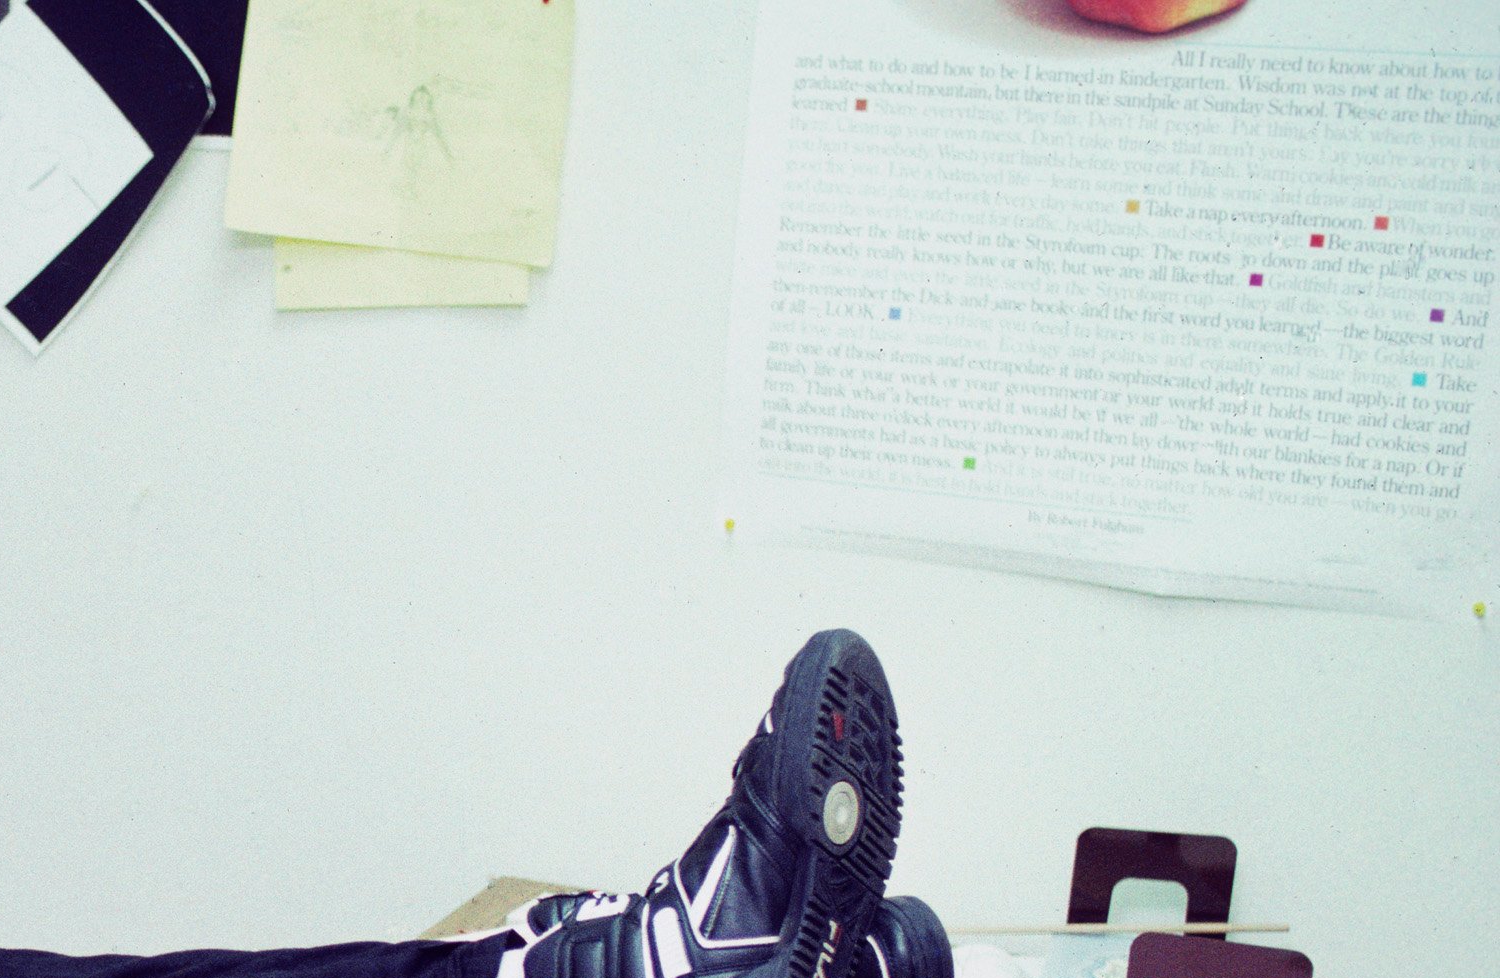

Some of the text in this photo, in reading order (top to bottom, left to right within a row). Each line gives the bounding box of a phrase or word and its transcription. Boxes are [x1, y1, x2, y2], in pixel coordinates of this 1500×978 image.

[794, 53, 825, 69] and
[826, 54, 865, 71] what
[866, 57, 885, 72] to
[886, 57, 909, 74] do
[909, 59, 941, 75] and
[941, 60, 975, 77] how
[977, 63, 997, 78] to
[998, 63, 1019, 80] be
[1023, 64, 1032, 80] I
[1034, 65, 1096, 84] learned
[1097, 69, 1115, 85] in
[1118, 69, 1232, 93] kindergarten.
[1237, 76, 1308, 96] Wisdom
[1312, 84, 1347, 98] was
[1349, 85, 1379, 100] not
[1382, 86, 1401, 101] at
[1404, 86, 1434, 103] the
[1438, 89, 1469, 109] top
[1174, 49, 1493, 82] All I really need to know about how to
[792, 74, 915, 95] graduate-school
[993, 84, 1021, 101] but
[1022, 86, 1061, 103] there
[1065, 88, 1083, 105] in
[1083, 89, 1110, 106] the
[1113, 92, 1177, 113] sandpile
[1182, 97, 1200, 112] at
[1202, 96, 1262, 119] Sunday
[1266, 99, 1331, 119] School.
[1389, 111, 1419, 124] are
[1422, 109, 1452, 126] the
[1144, 199, 1370, 231] Take a nap every afternoon.
[994, 231, 1021, 248] the
[1024, 232, 1108, 254] Styrofoam
[1152, 242, 1184, 260] The
[1187, 248, 1232, 264] roots
[1260, 250, 1308, 270] down
[1310, 255, 1344, 272] and
[1346, 257, 1375, 275] the
[1425, 266, 1468, 284] goes
[1470, 270, 1491, 288] up
[999, 255, 1017, 268] or
[1022, 254, 1057, 275] why,
[1060, 256, 1088, 274] but
[1091, 262, 1116, 276] we
[1118, 264, 1145, 278] are
[1148, 263, 1169, 280] all
[1170, 264, 1200, 283] like
[1201, 267, 1241, 286] that.
[1326, 233, 1352, 251] Be
[1356, 240, 1402, 255] aware
[1427, 243, 1495, 262] wonder.
[1451, 308, 1491, 327] And
[1107, 367, 1213, 390] sophisticated
[1258, 379, 1309, 398] terms
[1312, 384, 1345, 401] and
[1346, 388, 1390, 410] apply
[1394, 390, 1408, 407] it
[1411, 393, 1431, 409] to
[1433, 397, 1473, 415] your
[1434, 371, 1479, 392] Take
[1004, 380, 1473, 435] government your world and it holds true and clear and
[1020, 401, 1069, 419] would
[1071, 403, 1092, 421] be
[1208, 417, 1258, 436] whole
[1364, 433, 1432, 453] cookies
[1434, 439, 1469, 456] and
[779, 420, 1462, 499] governments had put things back where they found them and
[1130, 430, 1152, 452] lay
[1241, 444, 1270, 459] our
[1273, 443, 1343, 466] blankies
[1344, 450, 1369, 469] for
[1372, 457, 1384, 470] a
[1384, 458, 1423, 477] nap.
[1423, 458, 1450, 476] Or
